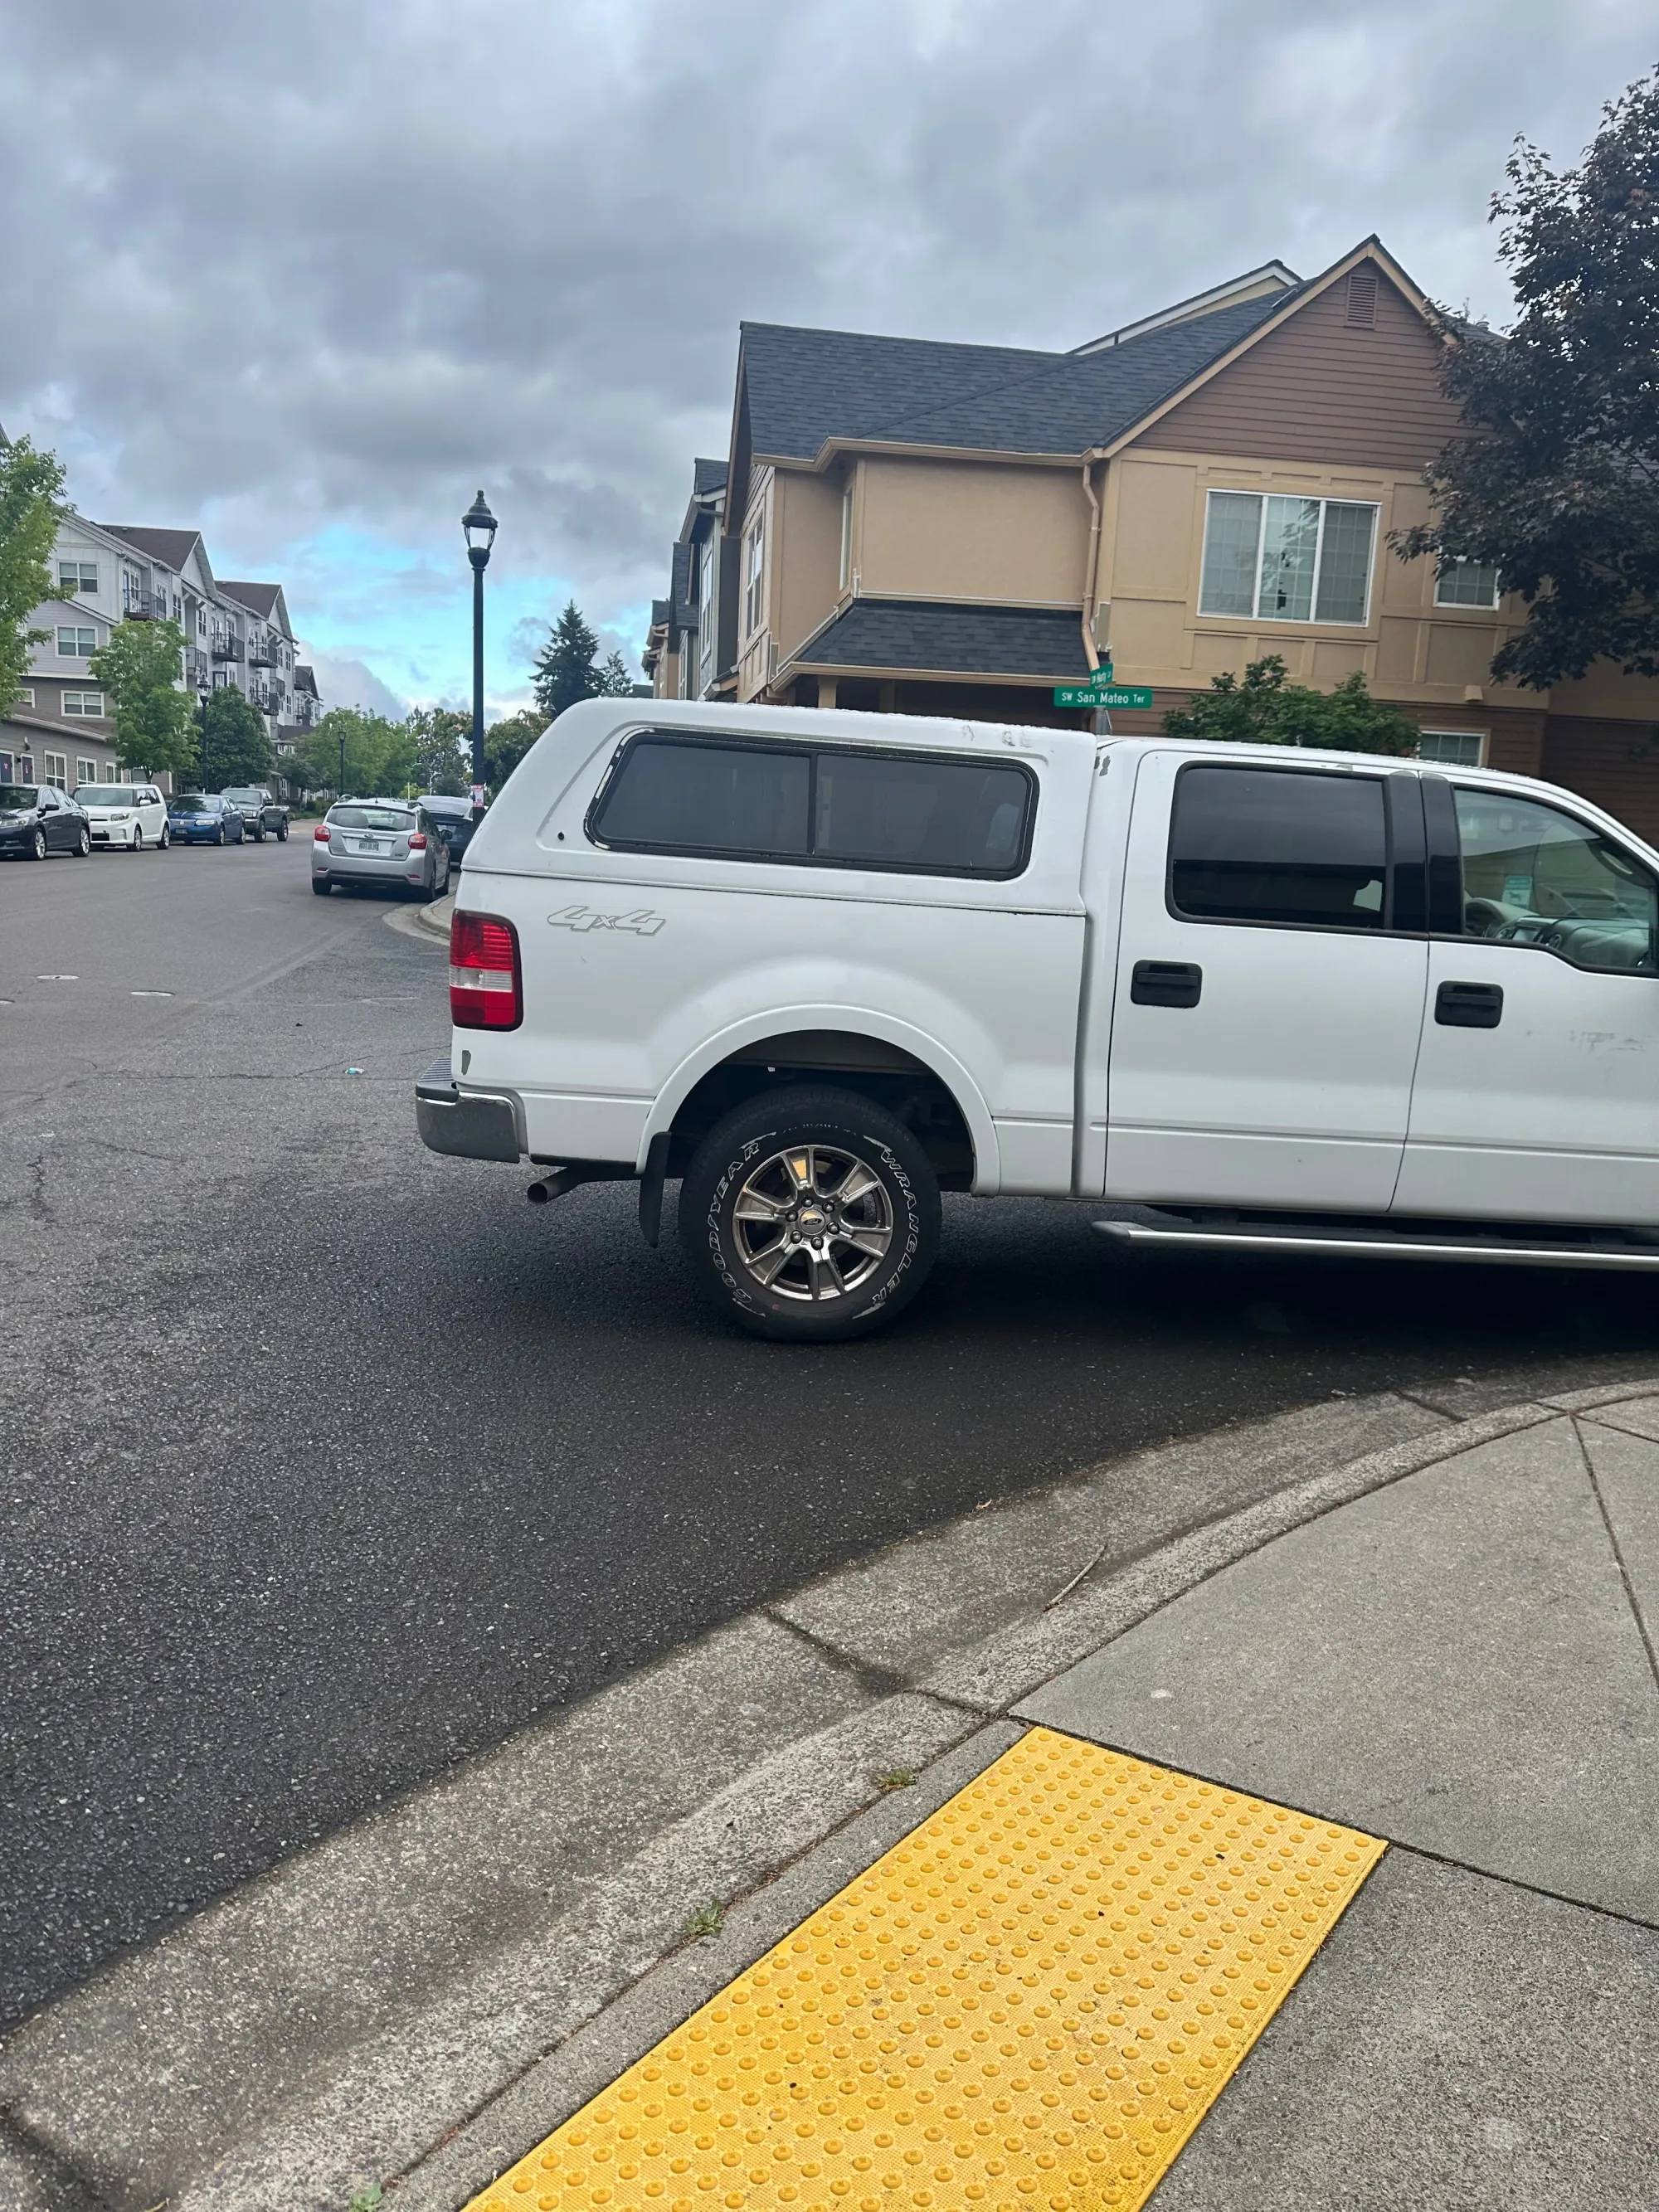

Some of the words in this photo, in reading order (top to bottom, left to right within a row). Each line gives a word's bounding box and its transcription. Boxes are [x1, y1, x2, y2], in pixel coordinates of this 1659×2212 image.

[1061, 692, 1073, 701] SW
[1077, 691, 1095, 703] San
[1100, 692, 1129, 704] Mateo
[1133, 693, 1145, 703] Ter
[547, 906, 668, 936] 4x4
[708, 1142, 761, 1304] GOODYEAR
[872, 1147, 921, 1306] WRANGLER
